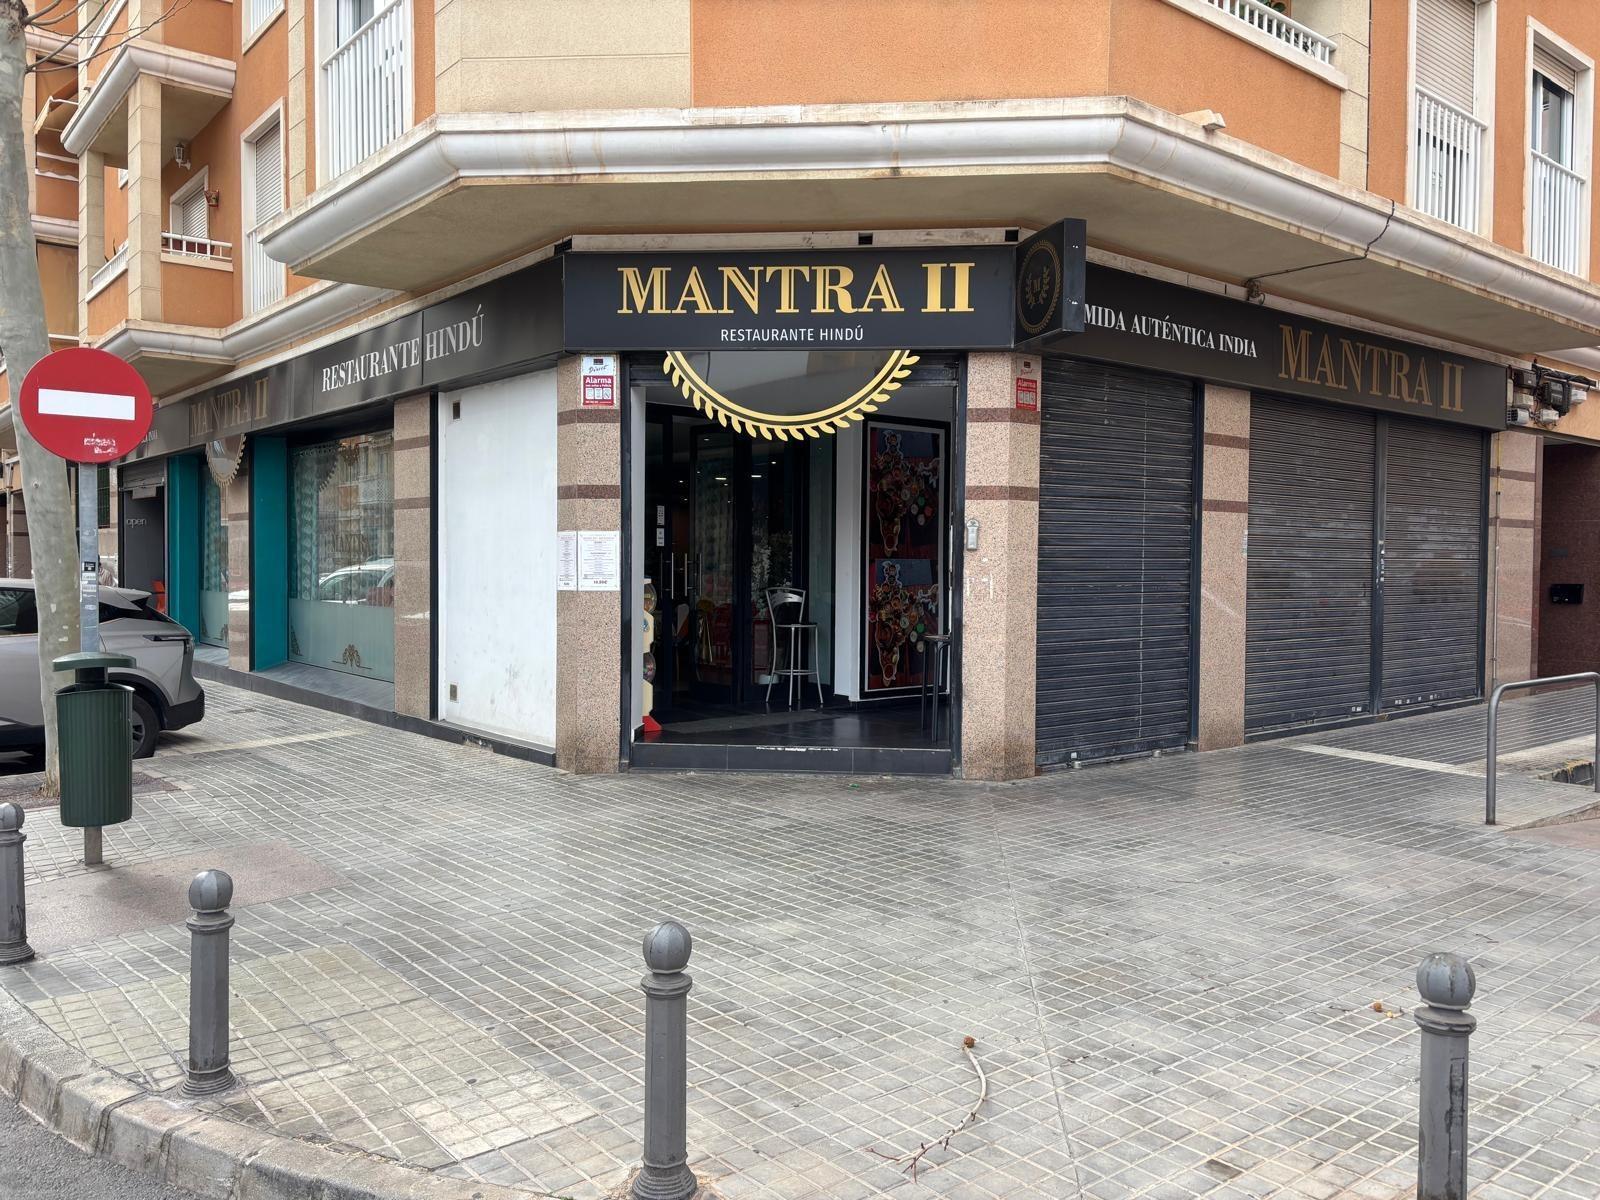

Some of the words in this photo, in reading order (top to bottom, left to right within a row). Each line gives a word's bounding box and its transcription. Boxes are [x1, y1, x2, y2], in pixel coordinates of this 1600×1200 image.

[616, 262, 904, 315] MANTRA
[920, 262, 976, 313] II
[321, 337, 421, 393] RESTAURANTE
[424, 303, 485, 362] HINDÚ
[720, 328, 815, 342] RESTAURANTE
[819, 324, 864, 341] HINDÚ
[1130, 314, 1216, 350] AUTÉNTICA
[1218, 333, 1258, 359] INDIA
[585, 376, 612, 384] Alarma
[1278, 324, 1433, 406] MANTRA
[1439, 360, 1465, 413] II
[190, 383, 252, 439] MANTRA
[253, 376, 270, 421] II
[126, 518, 147, 529] open
